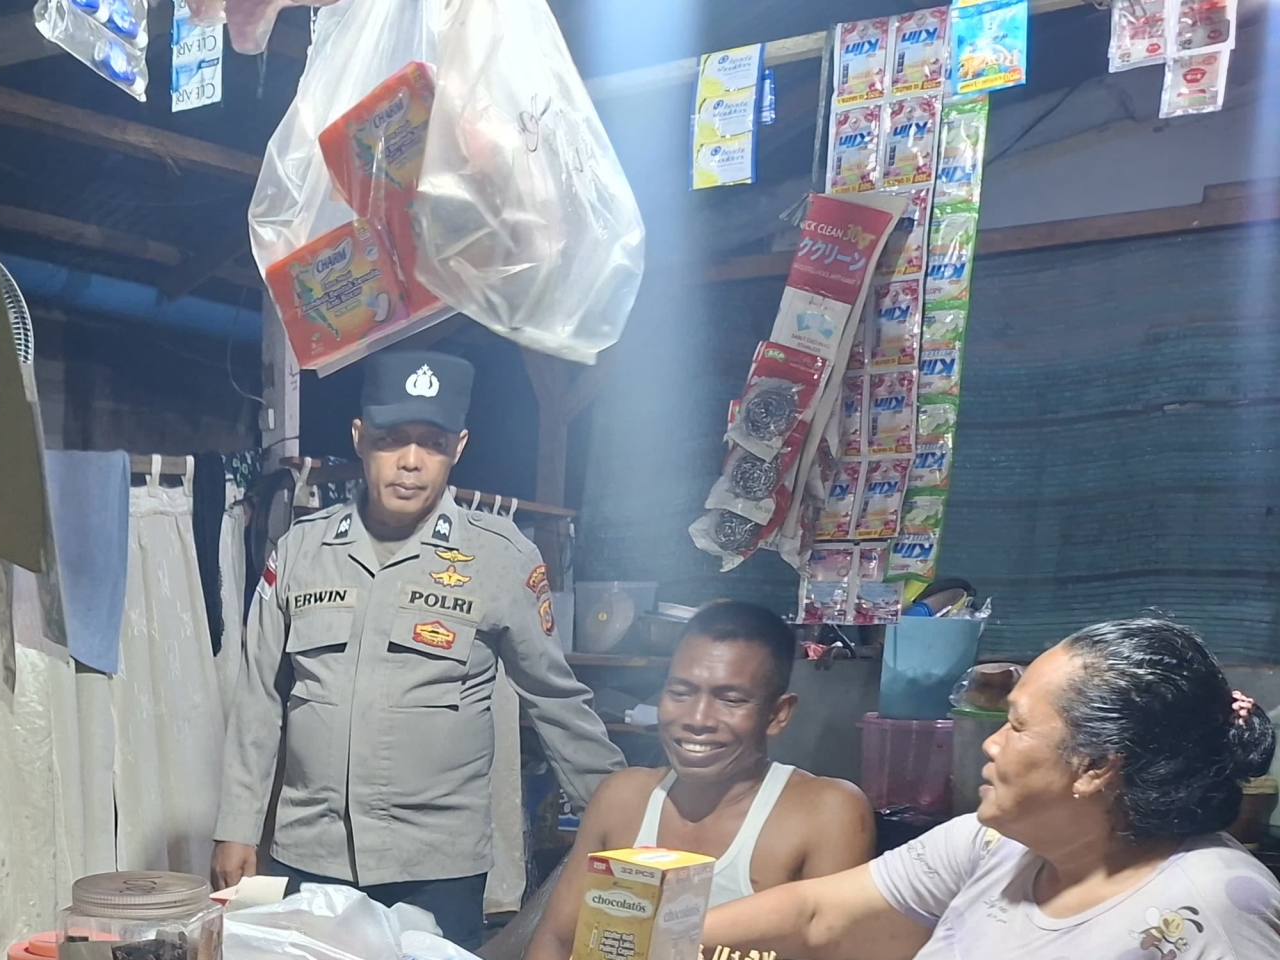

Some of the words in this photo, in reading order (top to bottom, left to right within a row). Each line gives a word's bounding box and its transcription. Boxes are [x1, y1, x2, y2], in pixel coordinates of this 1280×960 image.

[901, 27, 938, 44] Klin
[177, 35, 217, 58] CLEAR
[845, 38, 879, 56] Klin
[175, 83, 215, 105] CLEAR
[373, 98, 404, 128] CHARM
[893, 121, 928, 139] Klin
[818, 223, 844, 239] CLEAN
[316, 246, 347, 273] CHARM
[294, 589, 347, 609] ERWIN
[409, 590, 473, 615] POLRI
[593, 861, 606, 870] ISI
[620, 866, 633, 875] 32
[635, 869, 655, 879] PCS
